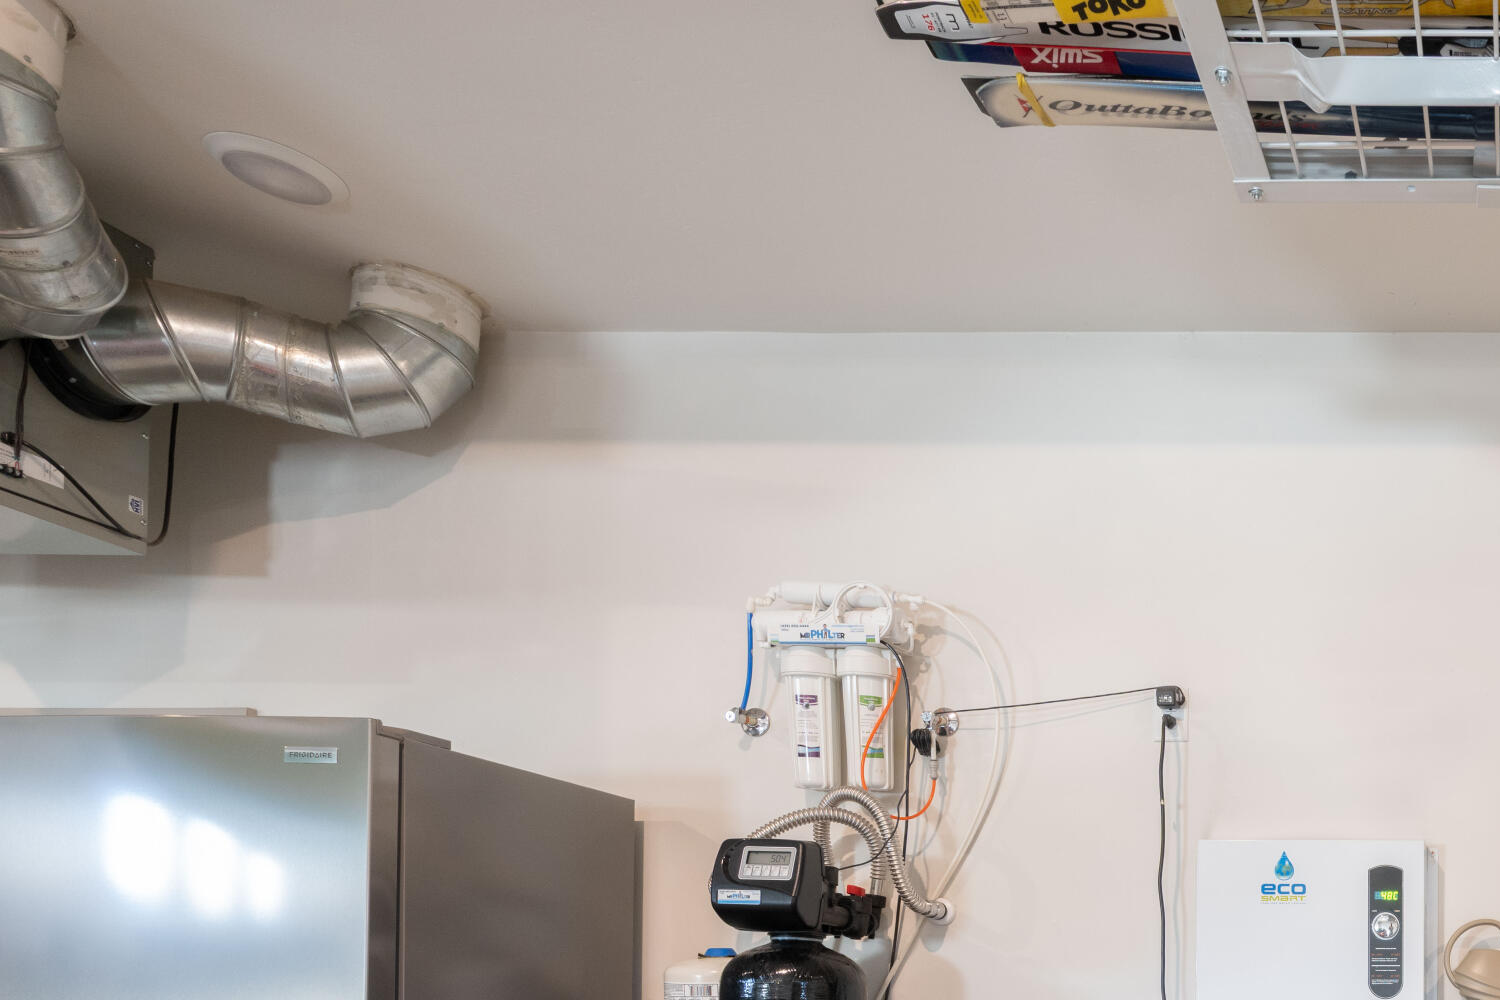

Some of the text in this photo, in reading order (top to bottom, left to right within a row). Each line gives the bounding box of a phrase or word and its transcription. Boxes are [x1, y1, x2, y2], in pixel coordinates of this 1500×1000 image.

[922, 13, 935, 31] 176
[289, 751, 333, 759] FRIGIDAIRE
[1261, 883, 1306, 895] eco
